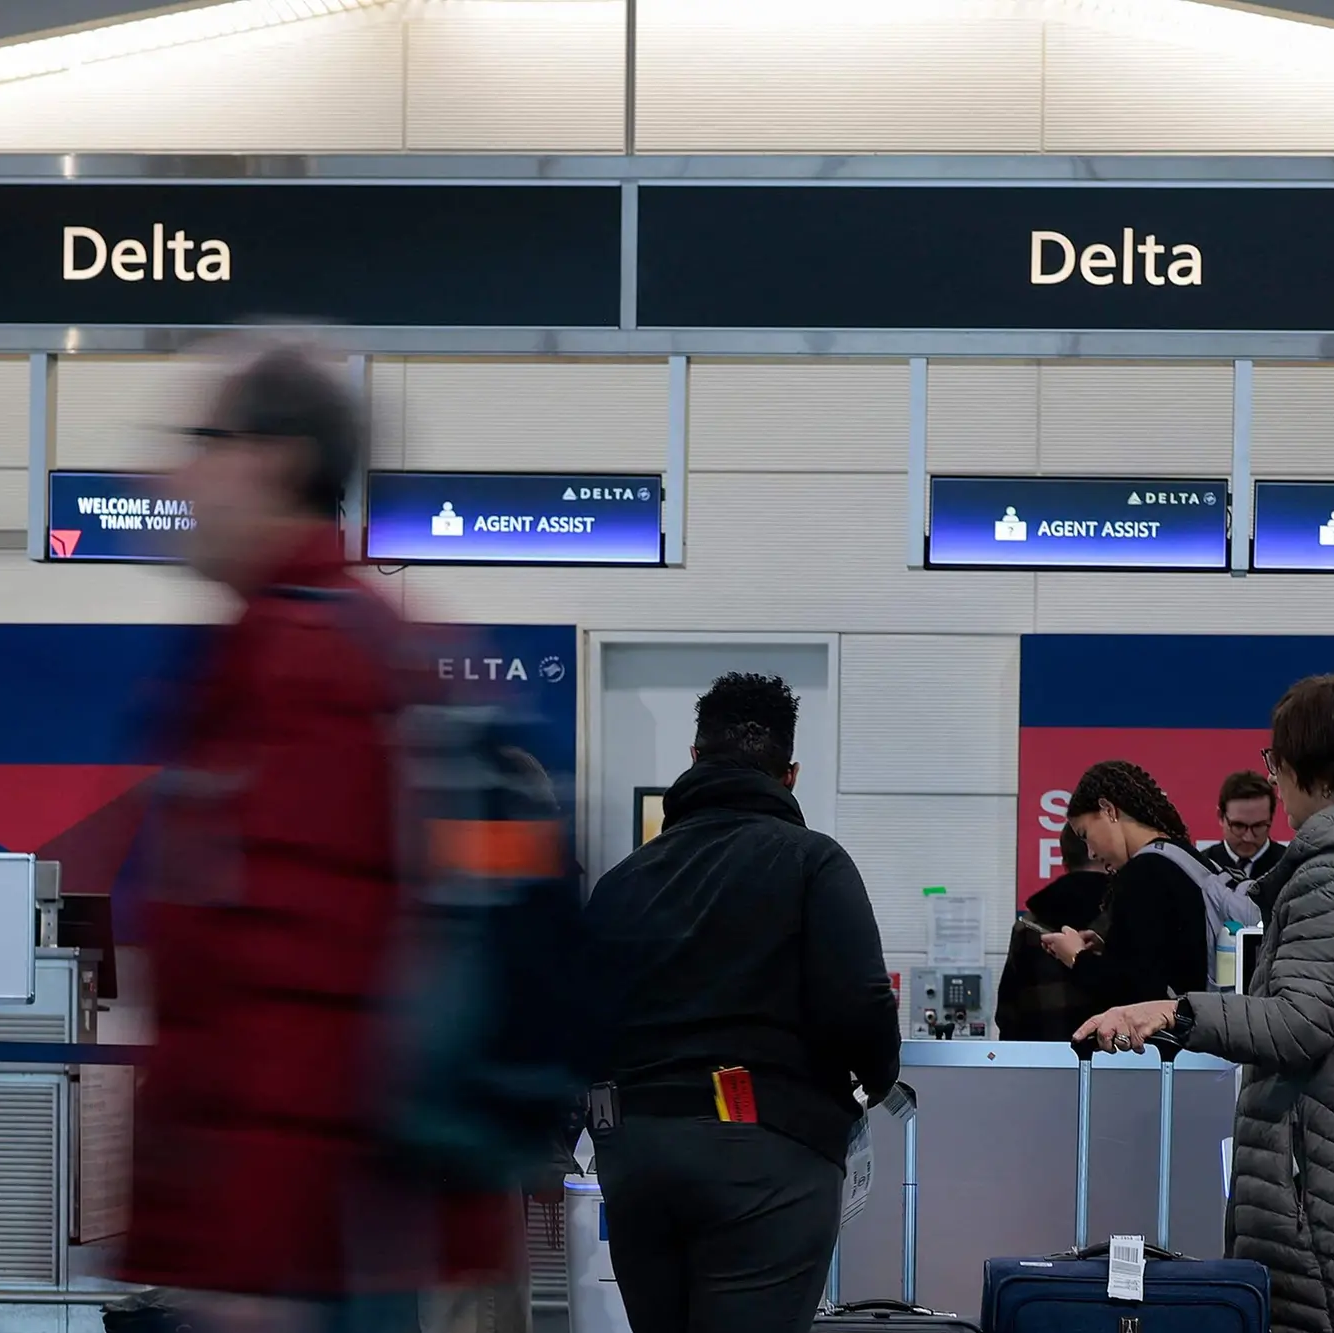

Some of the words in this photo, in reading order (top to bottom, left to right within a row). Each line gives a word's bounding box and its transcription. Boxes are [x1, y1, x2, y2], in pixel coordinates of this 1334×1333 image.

[63, 223, 231, 282] Delta
[1030, 227, 1202, 286] Delta
[579, 488, 634, 500] DELTA
[1146, 492, 1200, 505] DELTA
[77, 497, 151, 515] WELCOME
[154, 500, 195, 516] AMAZ
[99, 515, 143, 530] THANK
[145, 516, 171, 530] YOU
[474, 515, 534, 532] AGENT
[536, 516, 595, 533] ASSIST
[1037, 521, 1098, 537] AGENT
[1101, 521, 1160, 538] ASSIST
[438, 658, 528, 681] ELTA
